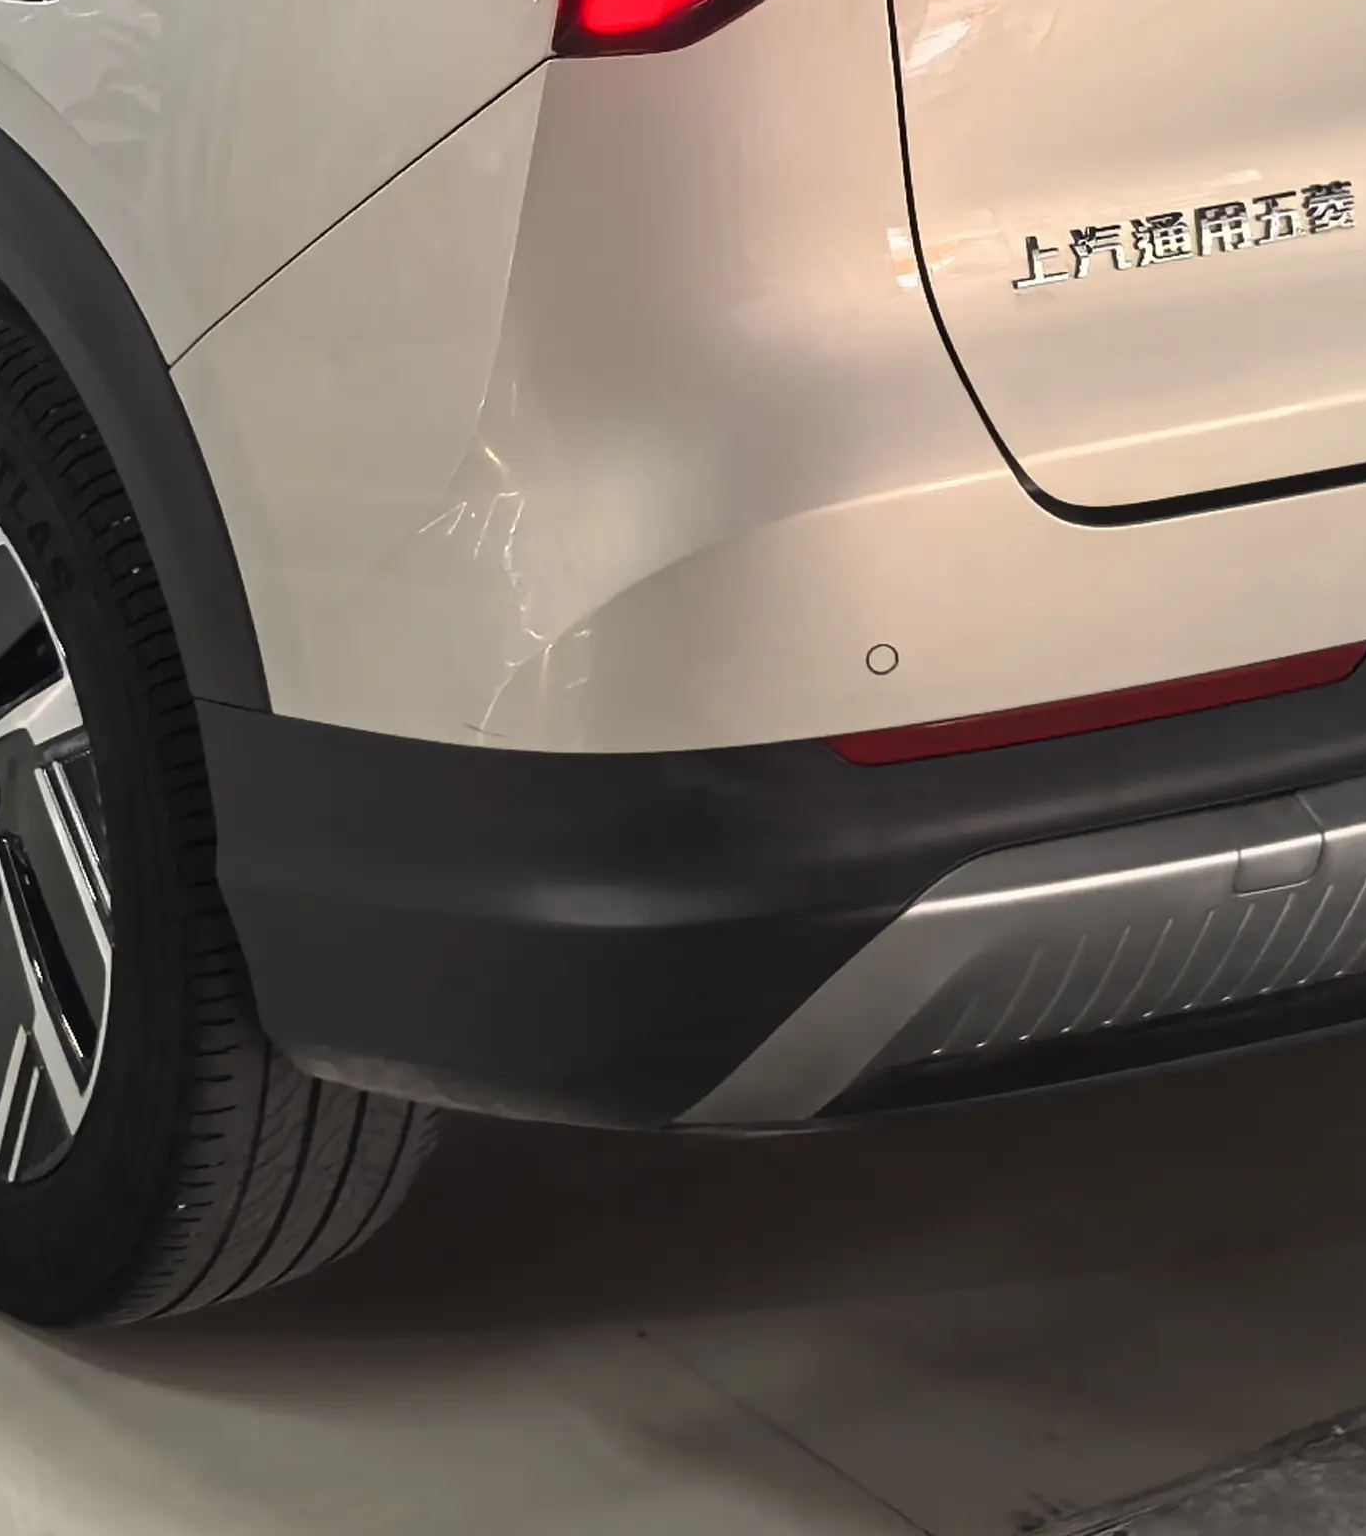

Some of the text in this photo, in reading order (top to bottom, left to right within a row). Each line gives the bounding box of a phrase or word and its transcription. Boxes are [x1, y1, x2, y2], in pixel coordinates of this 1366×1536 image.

[1011, 178, 1357, 293] 上汽通用五菱
